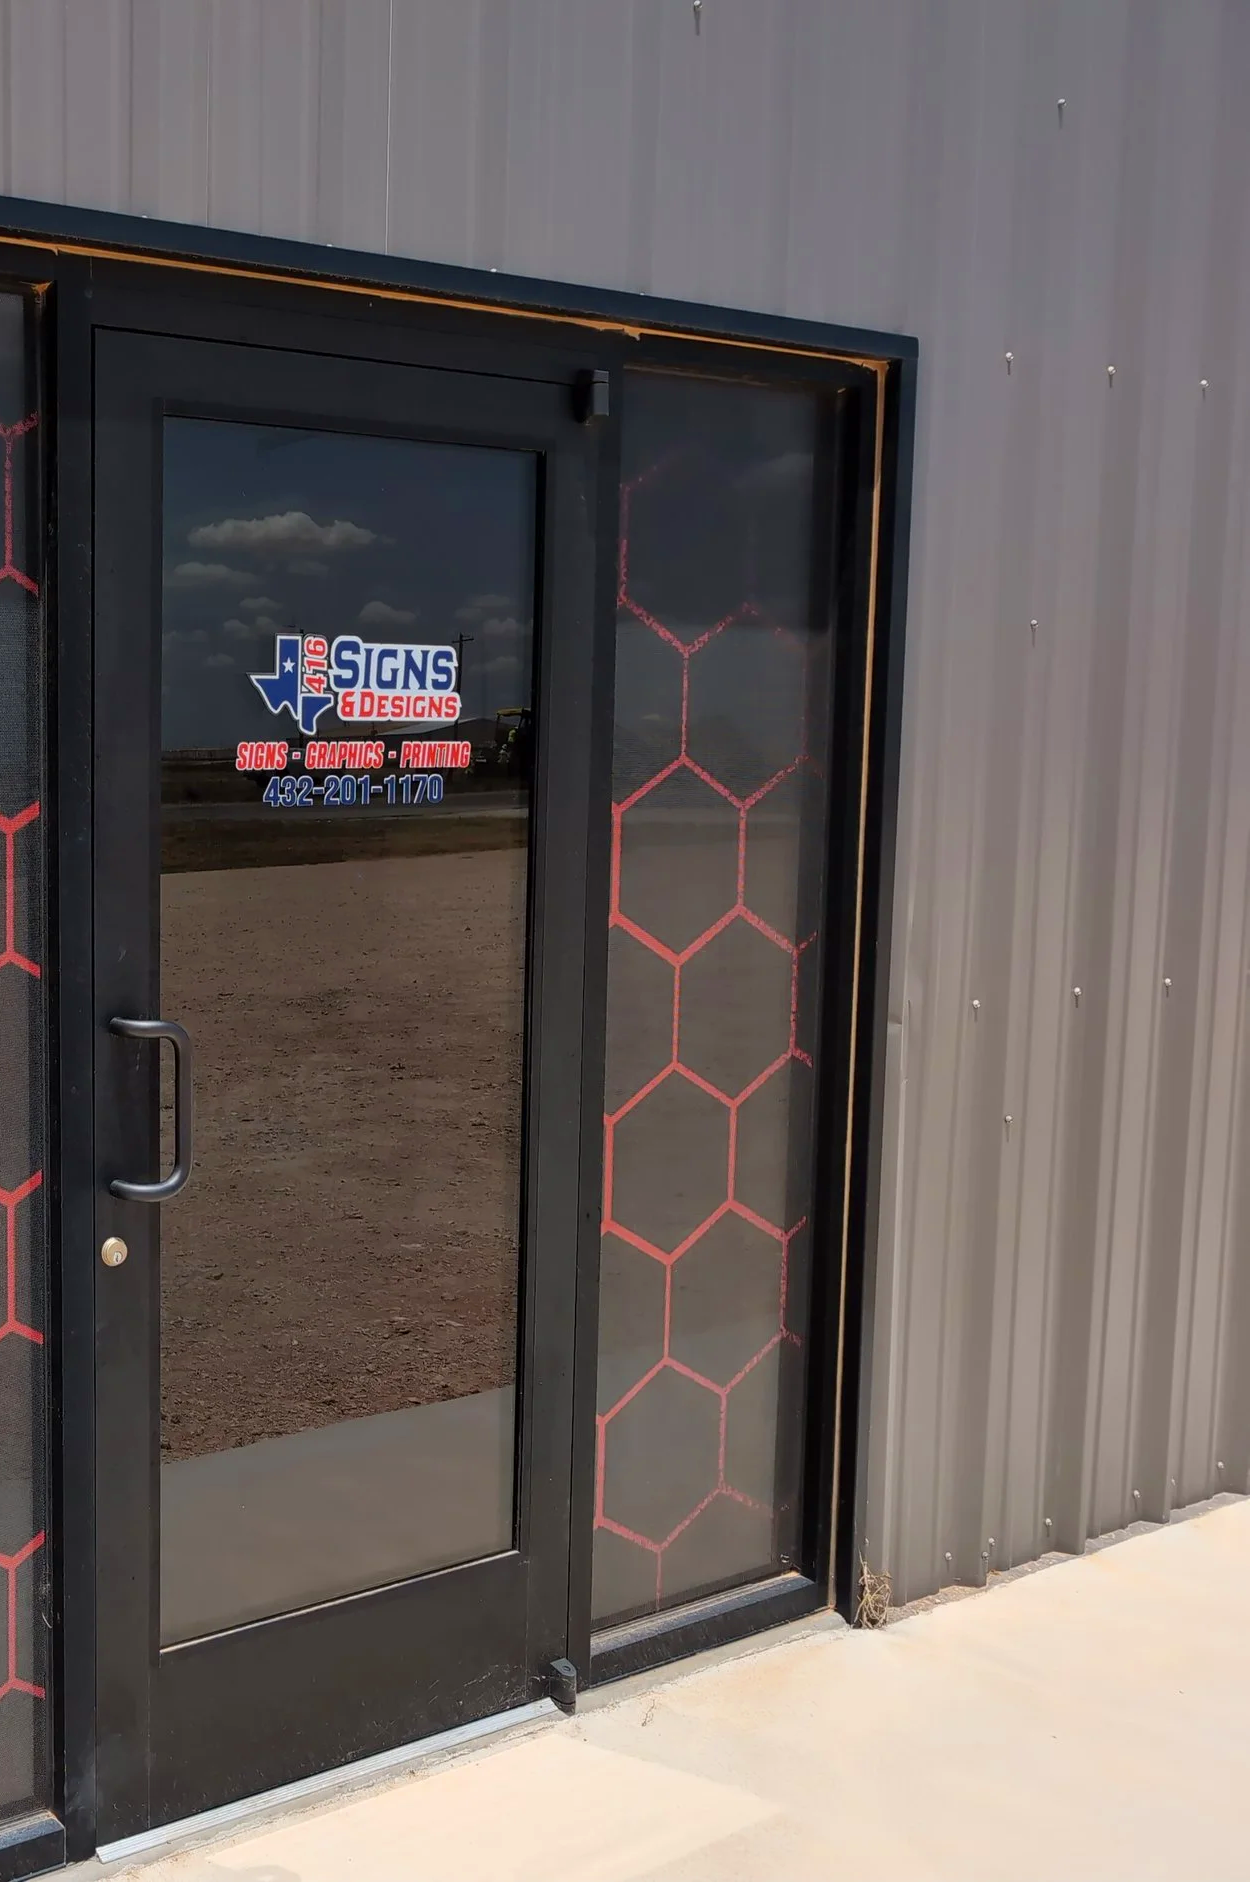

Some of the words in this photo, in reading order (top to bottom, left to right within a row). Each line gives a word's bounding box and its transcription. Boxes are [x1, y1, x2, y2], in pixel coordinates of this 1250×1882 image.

[304, 637, 328, 694] 416
[305, 742, 384, 769] GRAPHICS
[400, 741, 471, 768] PRINTING
[263, 774, 444, 807] 432-201-1170
